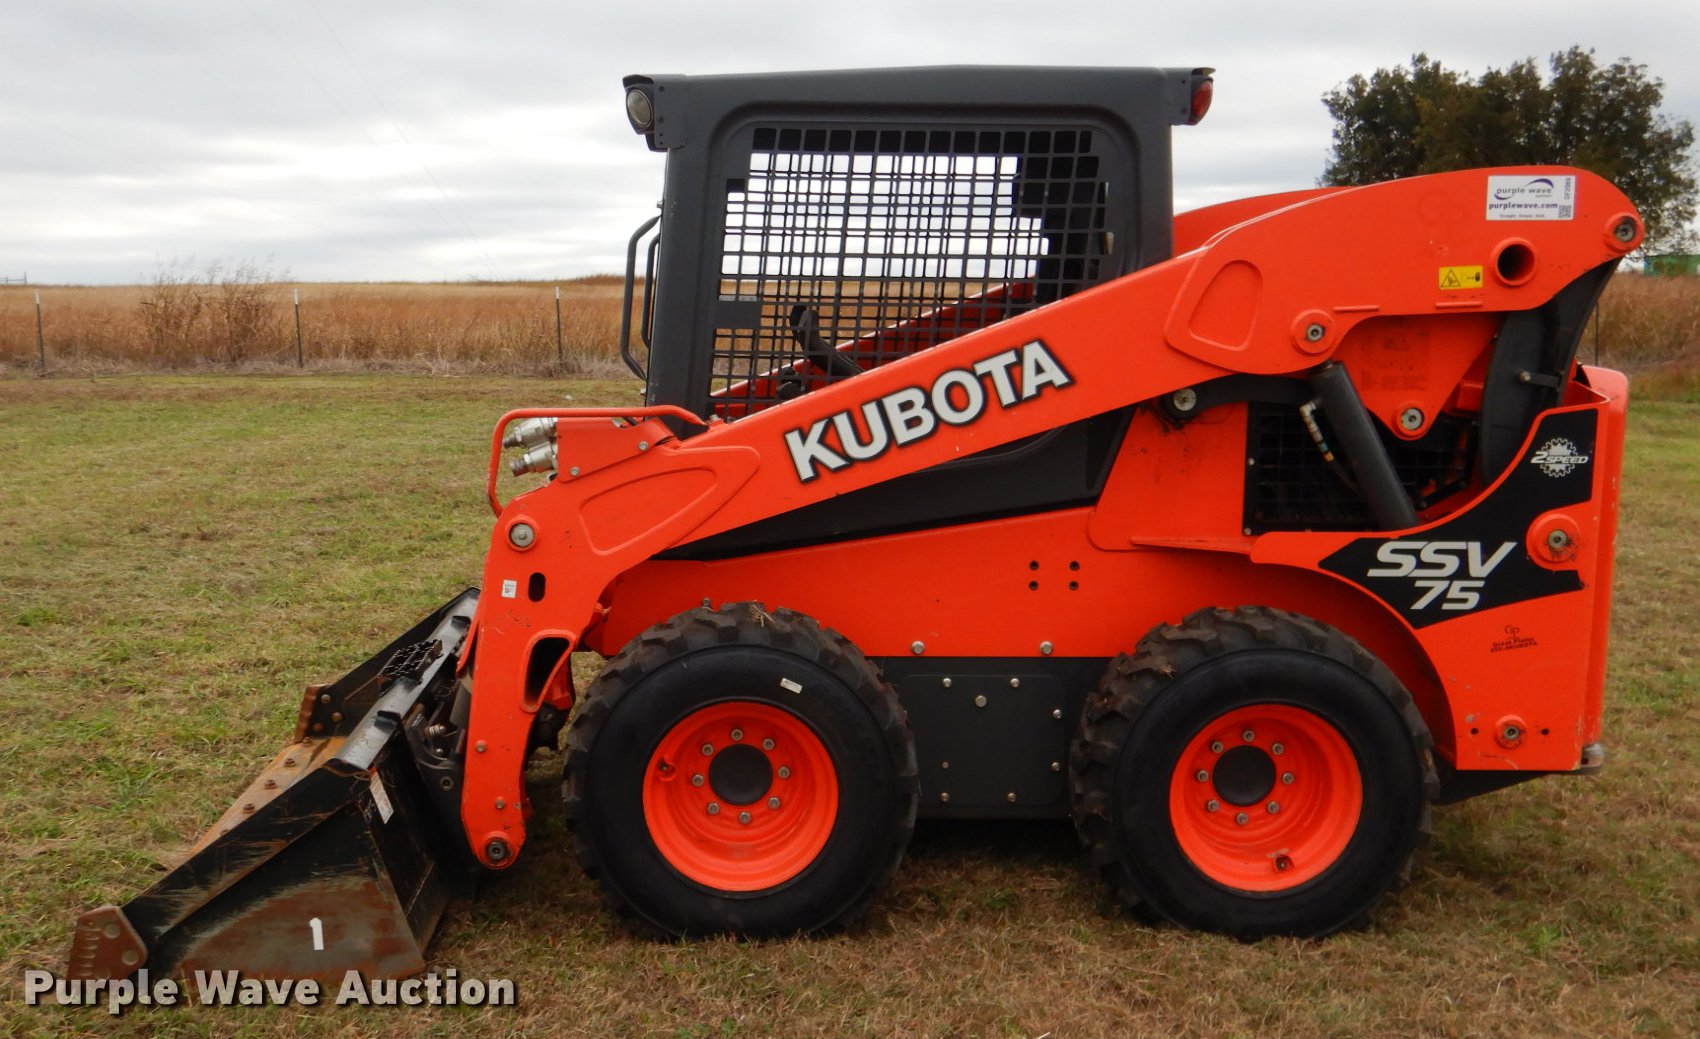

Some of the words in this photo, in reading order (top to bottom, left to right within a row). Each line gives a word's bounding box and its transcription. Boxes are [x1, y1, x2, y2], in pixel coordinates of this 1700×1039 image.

[1488, 202, 1558, 210] purplewave.com
[1496, 187, 1526, 195] purple
[784, 340, 1074, 482] KUBOTA
[1367, 540, 1518, 578] SSV
[1409, 580, 1485, 610] 75
[309, 917, 324, 950] 1
